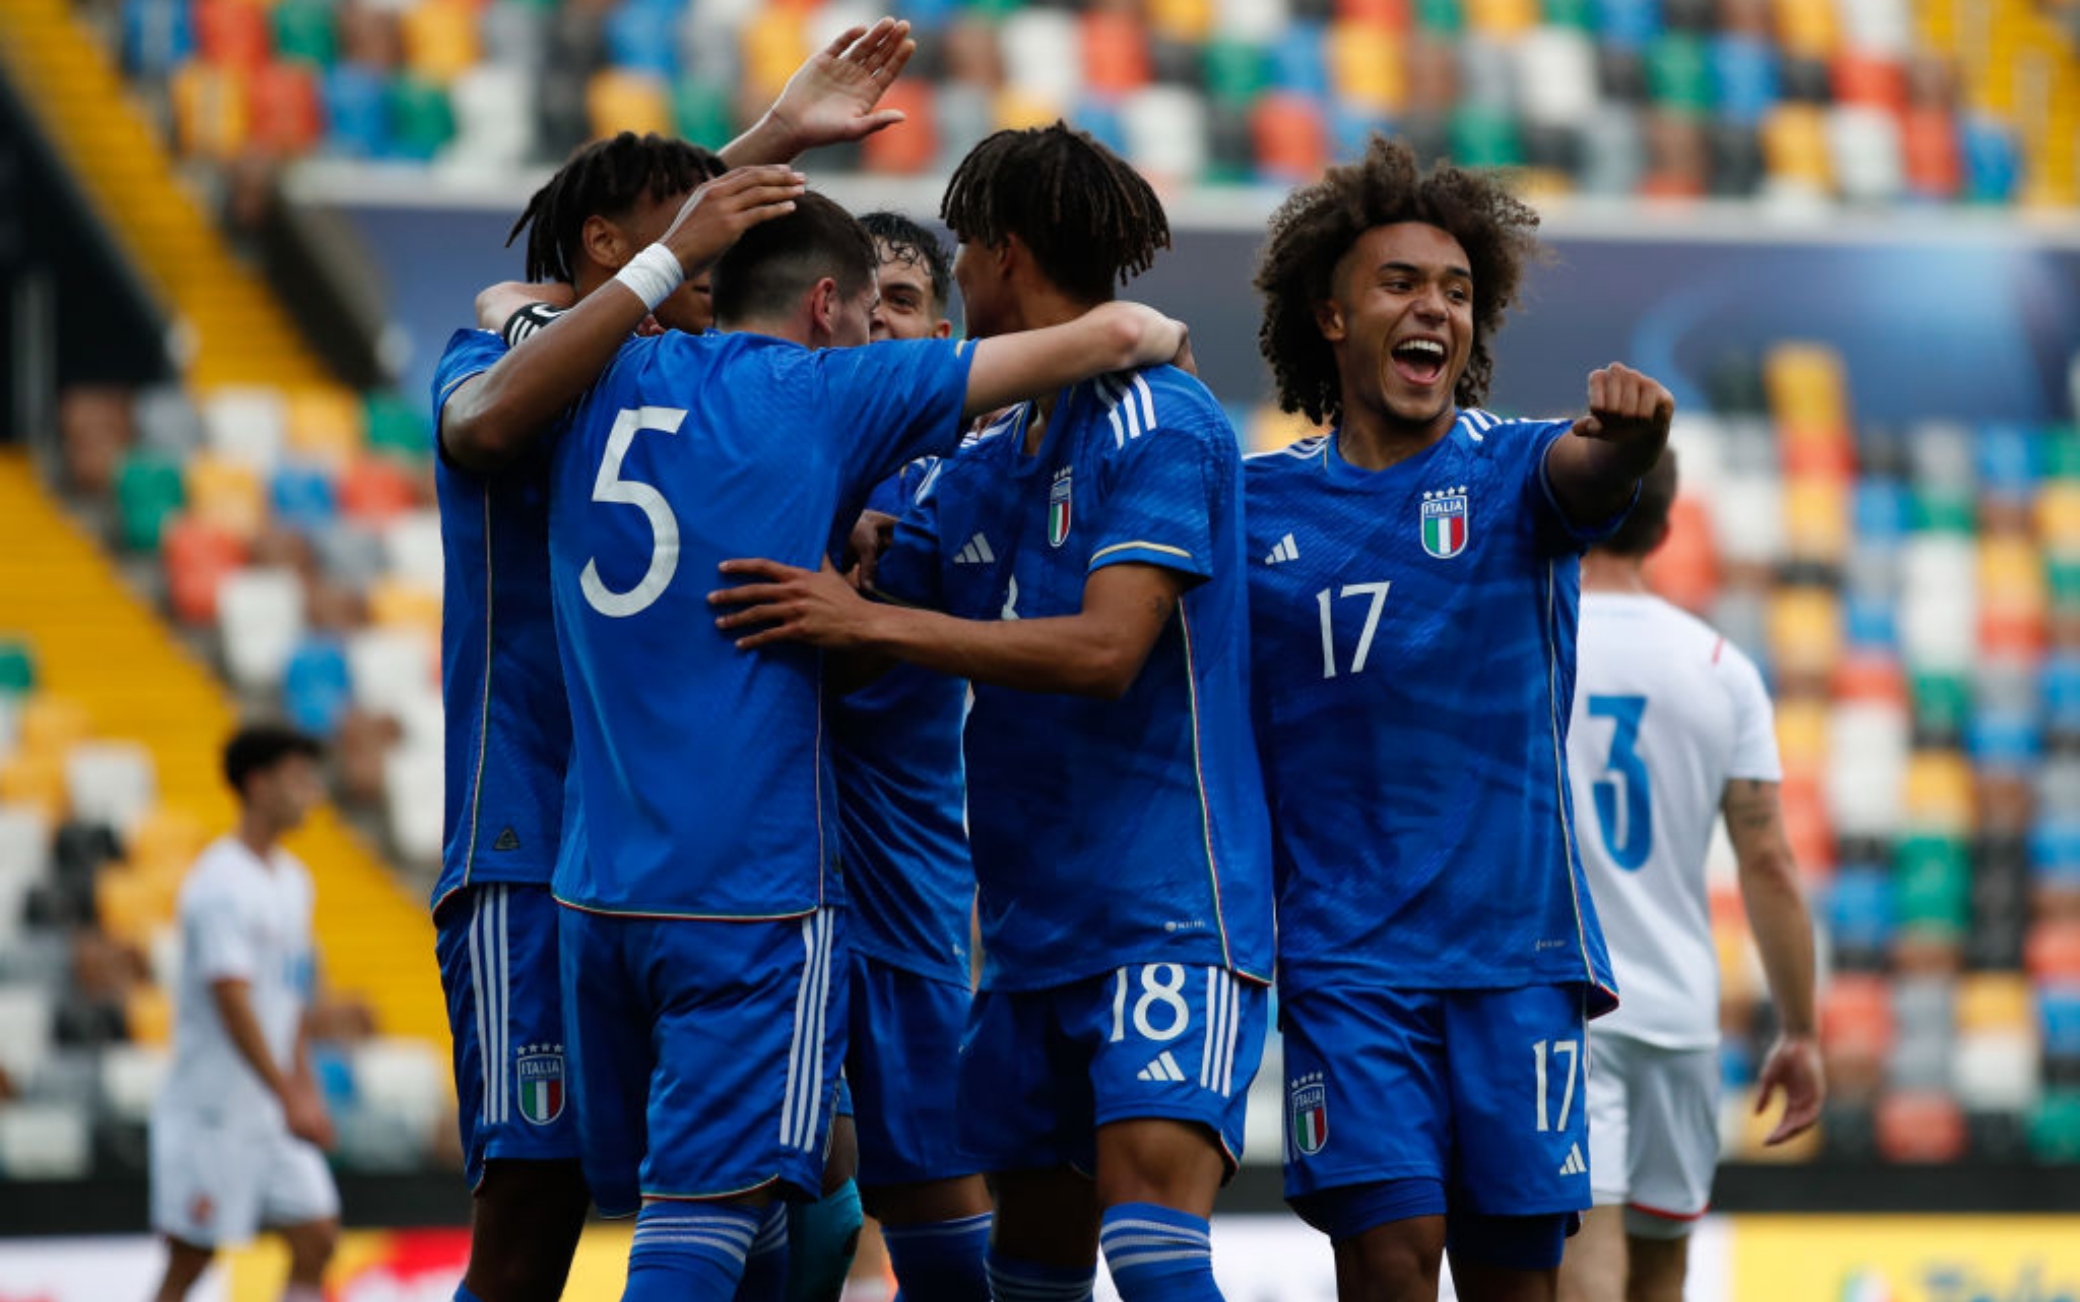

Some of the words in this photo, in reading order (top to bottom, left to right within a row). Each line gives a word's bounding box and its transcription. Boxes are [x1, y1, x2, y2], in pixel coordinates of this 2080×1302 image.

[580, 406, 688, 618] 5
[1425, 499, 1463, 515] ITALIA
[1316, 581, 1391, 679] 17
[1587, 695, 1652, 872] 3
[1110, 963, 1189, 1042] 18
[521, 1060, 560, 1076] ITALIA
[1533, 1039, 1578, 1132] 17
